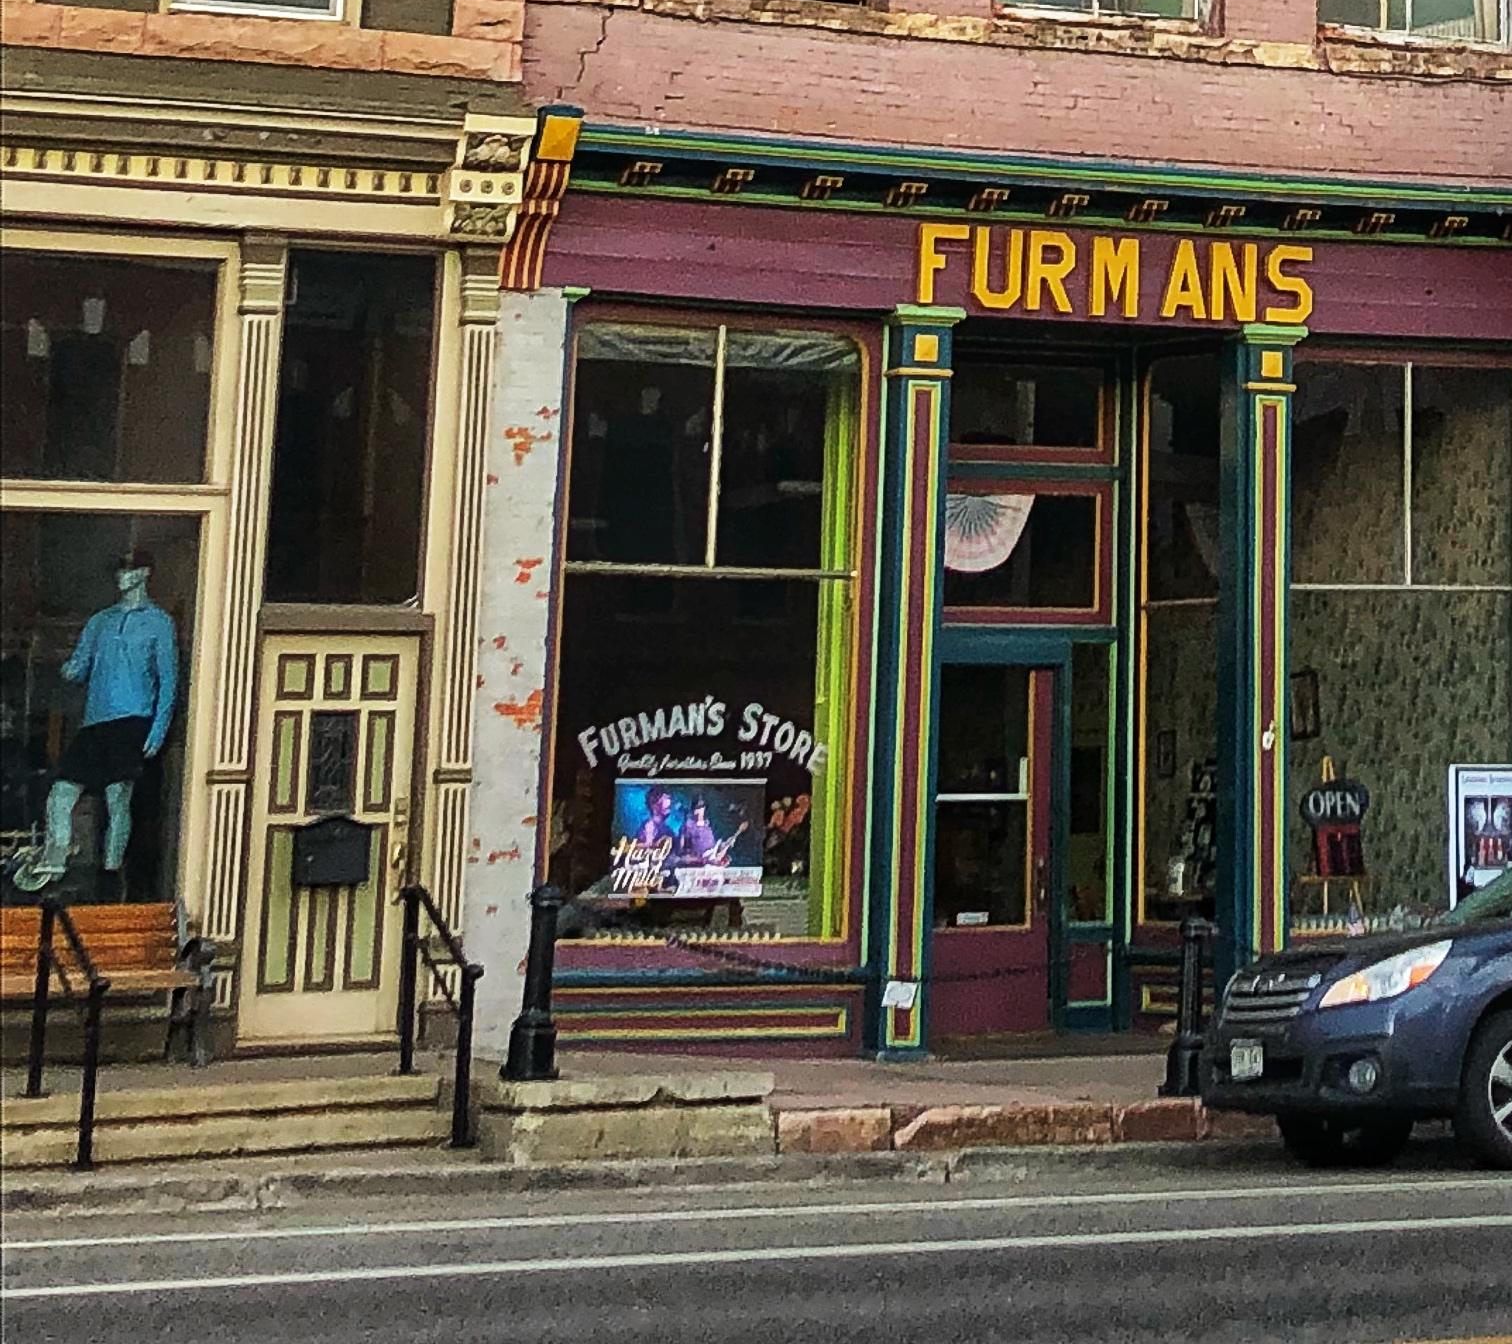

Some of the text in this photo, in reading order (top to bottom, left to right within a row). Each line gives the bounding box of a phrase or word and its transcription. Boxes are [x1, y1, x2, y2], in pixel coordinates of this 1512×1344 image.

[577, 694, 829, 774] FURMAN'S STORE
[1308, 790, 1361, 817] OPEN
